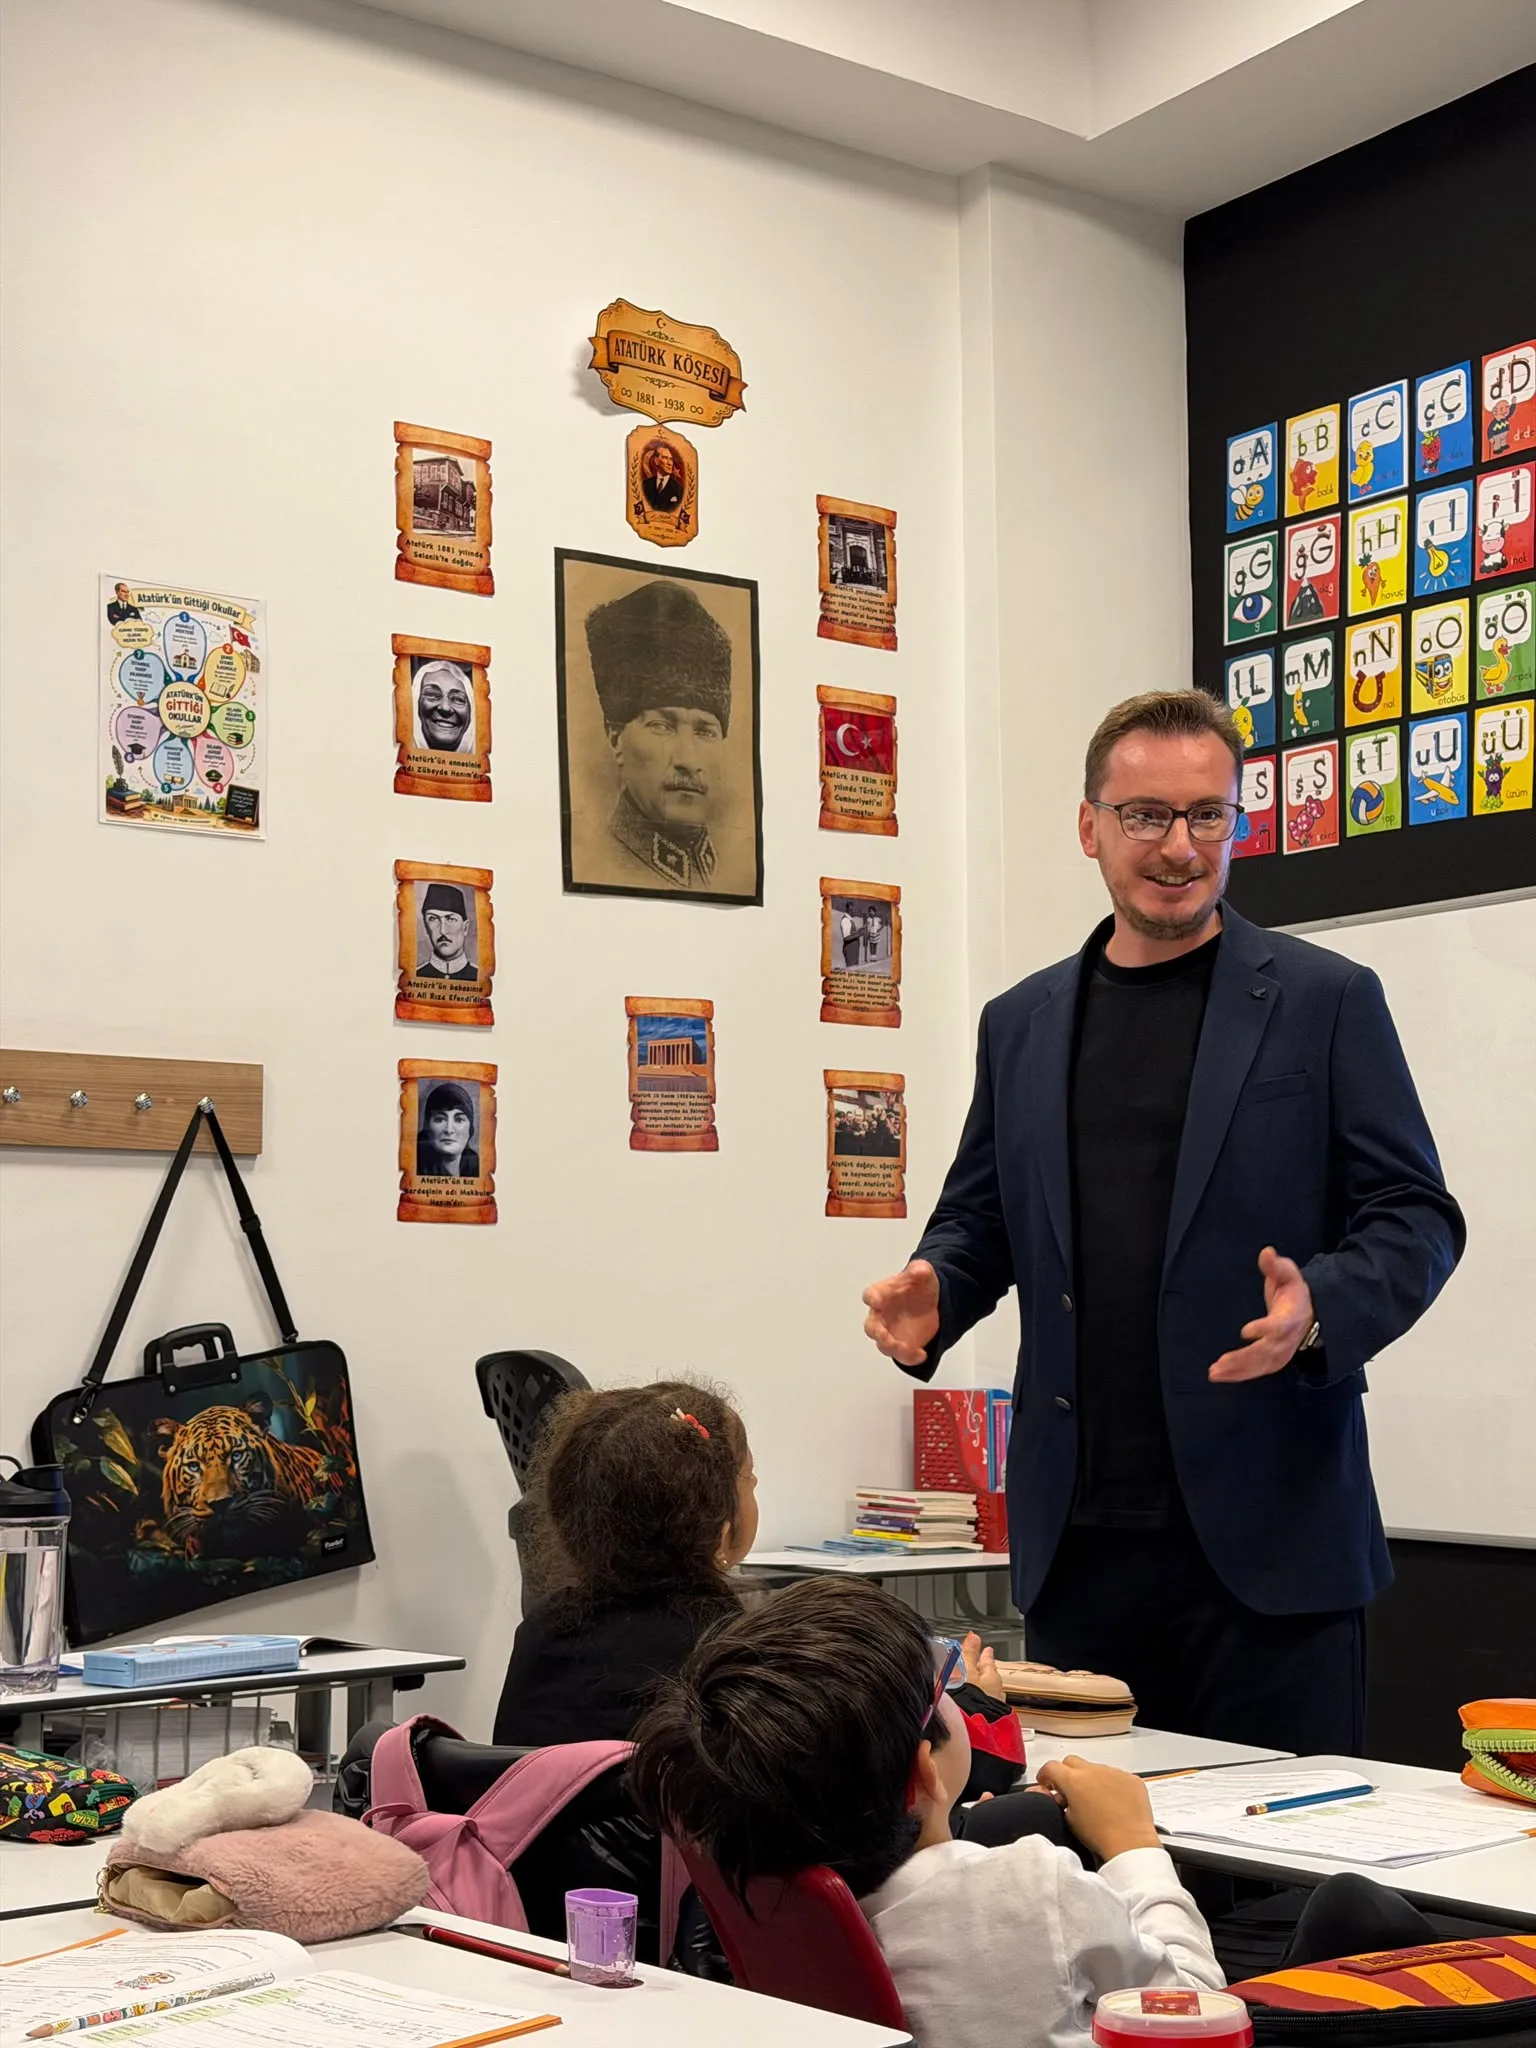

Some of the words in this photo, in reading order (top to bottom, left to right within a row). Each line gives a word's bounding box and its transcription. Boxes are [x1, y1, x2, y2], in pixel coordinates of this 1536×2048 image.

[614, 337, 667, 367] ATATÜRK
[673, 352, 726, 387] KÖŞESİ
[636, 391, 655, 405] 1881
[664, 398, 685, 412] 1938
[406, 539, 434, 550] Atatürk
[437, 544, 455, 554] 1881
[458, 549, 484, 559] yılında
[413, 551, 449, 563] Selanik'te
[452, 557, 477, 567] doğdu.
[1380, 588, 1405, 601] havuç
[137, 593, 182, 605] Atatürk'ün
[184, 596, 210, 611] Gittiği
[212, 602, 242, 619] Okullar
[166, 690, 203, 702] ATATÜRK'ÜN
[1383, 696, 1396, 709] nal
[1437, 692, 1466, 706] otobüs
[165, 701, 203, 715] GİTTİĞİ
[168, 713, 202, 724] OKULLAR
[407, 754, 446, 765] Atatürk'ün
[449, 760, 482, 769] annesinin
[416, 766, 448, 776] Zübeyde
[821, 770, 848, 781] Atatürk
[862, 776, 877, 785] Ekim
[834, 784, 857, 793] yılında
[859, 787, 884, 797] Türkiye
[1505, 788, 1529, 800] üzüm
[834, 794, 883, 807] Cumhuriyeti'ni
[407, 981, 447, 990] Atatürk'ün
[450, 984, 484, 993] babasının
[430, 993, 446, 1001] Rıza
[420, 1177, 461, 1185] Atatürk'ün
